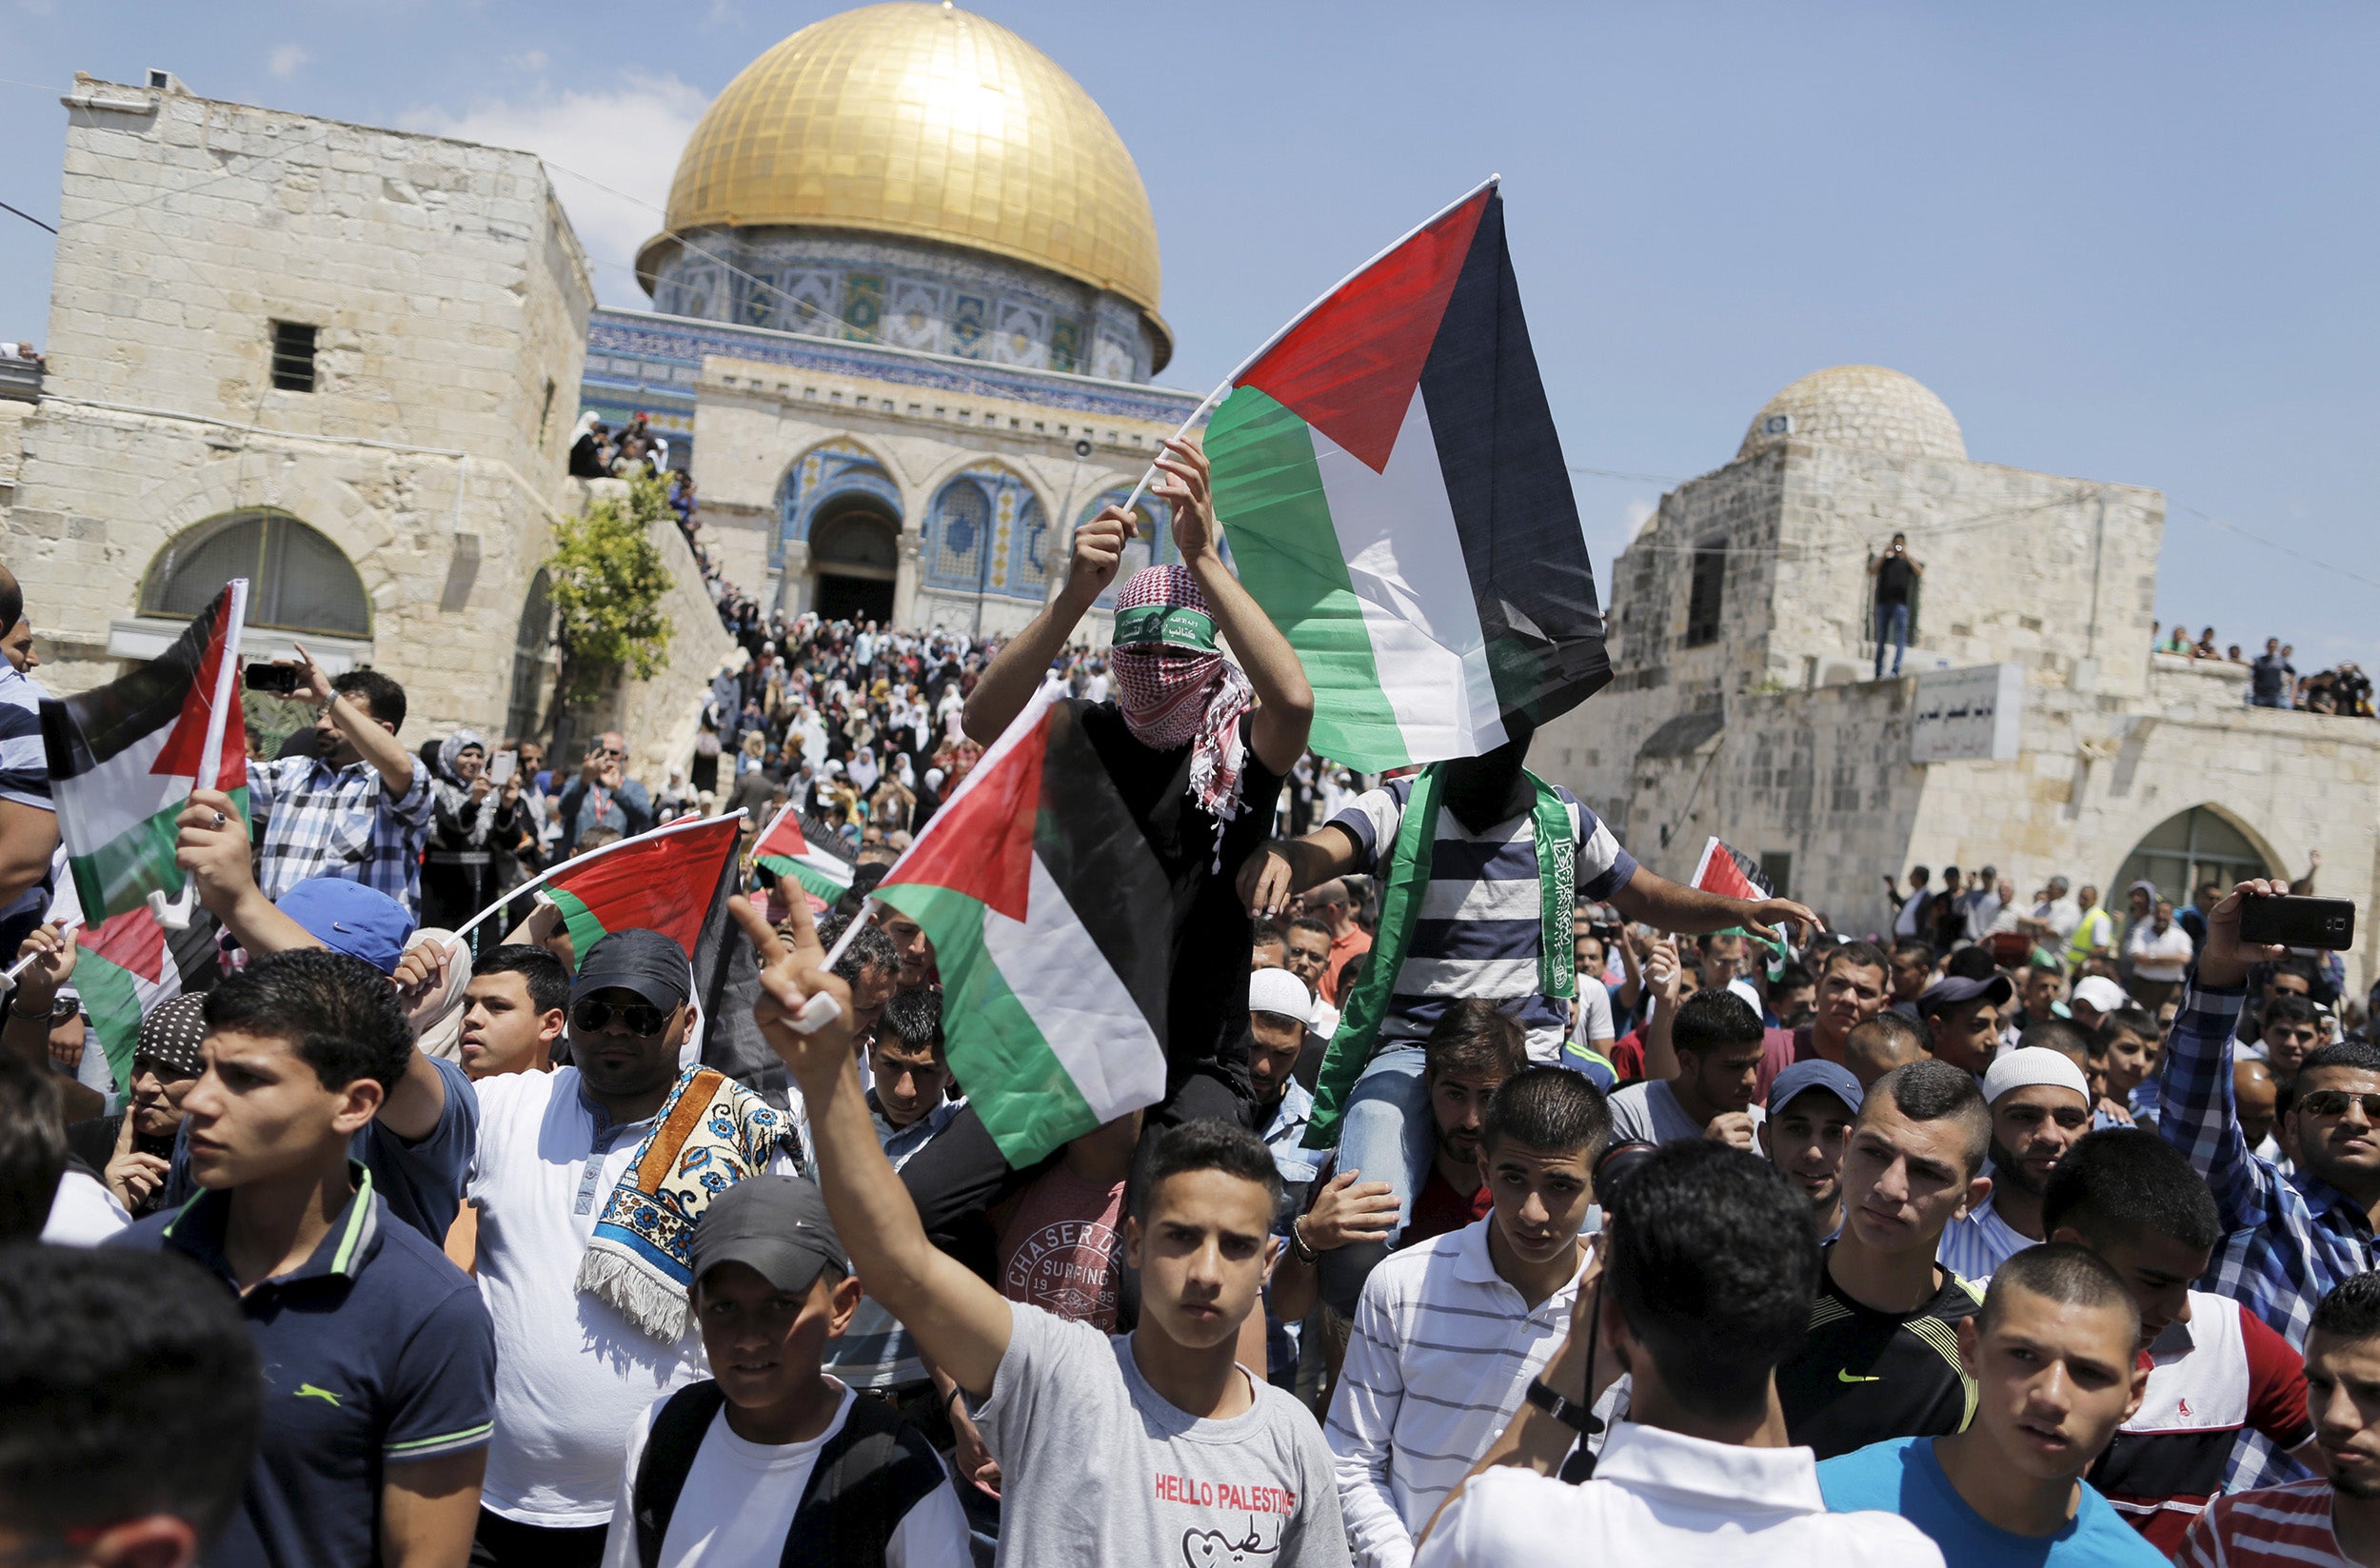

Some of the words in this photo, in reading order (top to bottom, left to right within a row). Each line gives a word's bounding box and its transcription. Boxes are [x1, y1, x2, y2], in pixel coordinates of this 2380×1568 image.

[1009, 1223, 1093, 1287] CHASER
[1042, 1260, 1109, 1286] SURFING
[1033, 1278, 1048, 1290] 19
[1099, 1291, 1115, 1303] 85
[1155, 1473, 1214, 1507] HELLO
